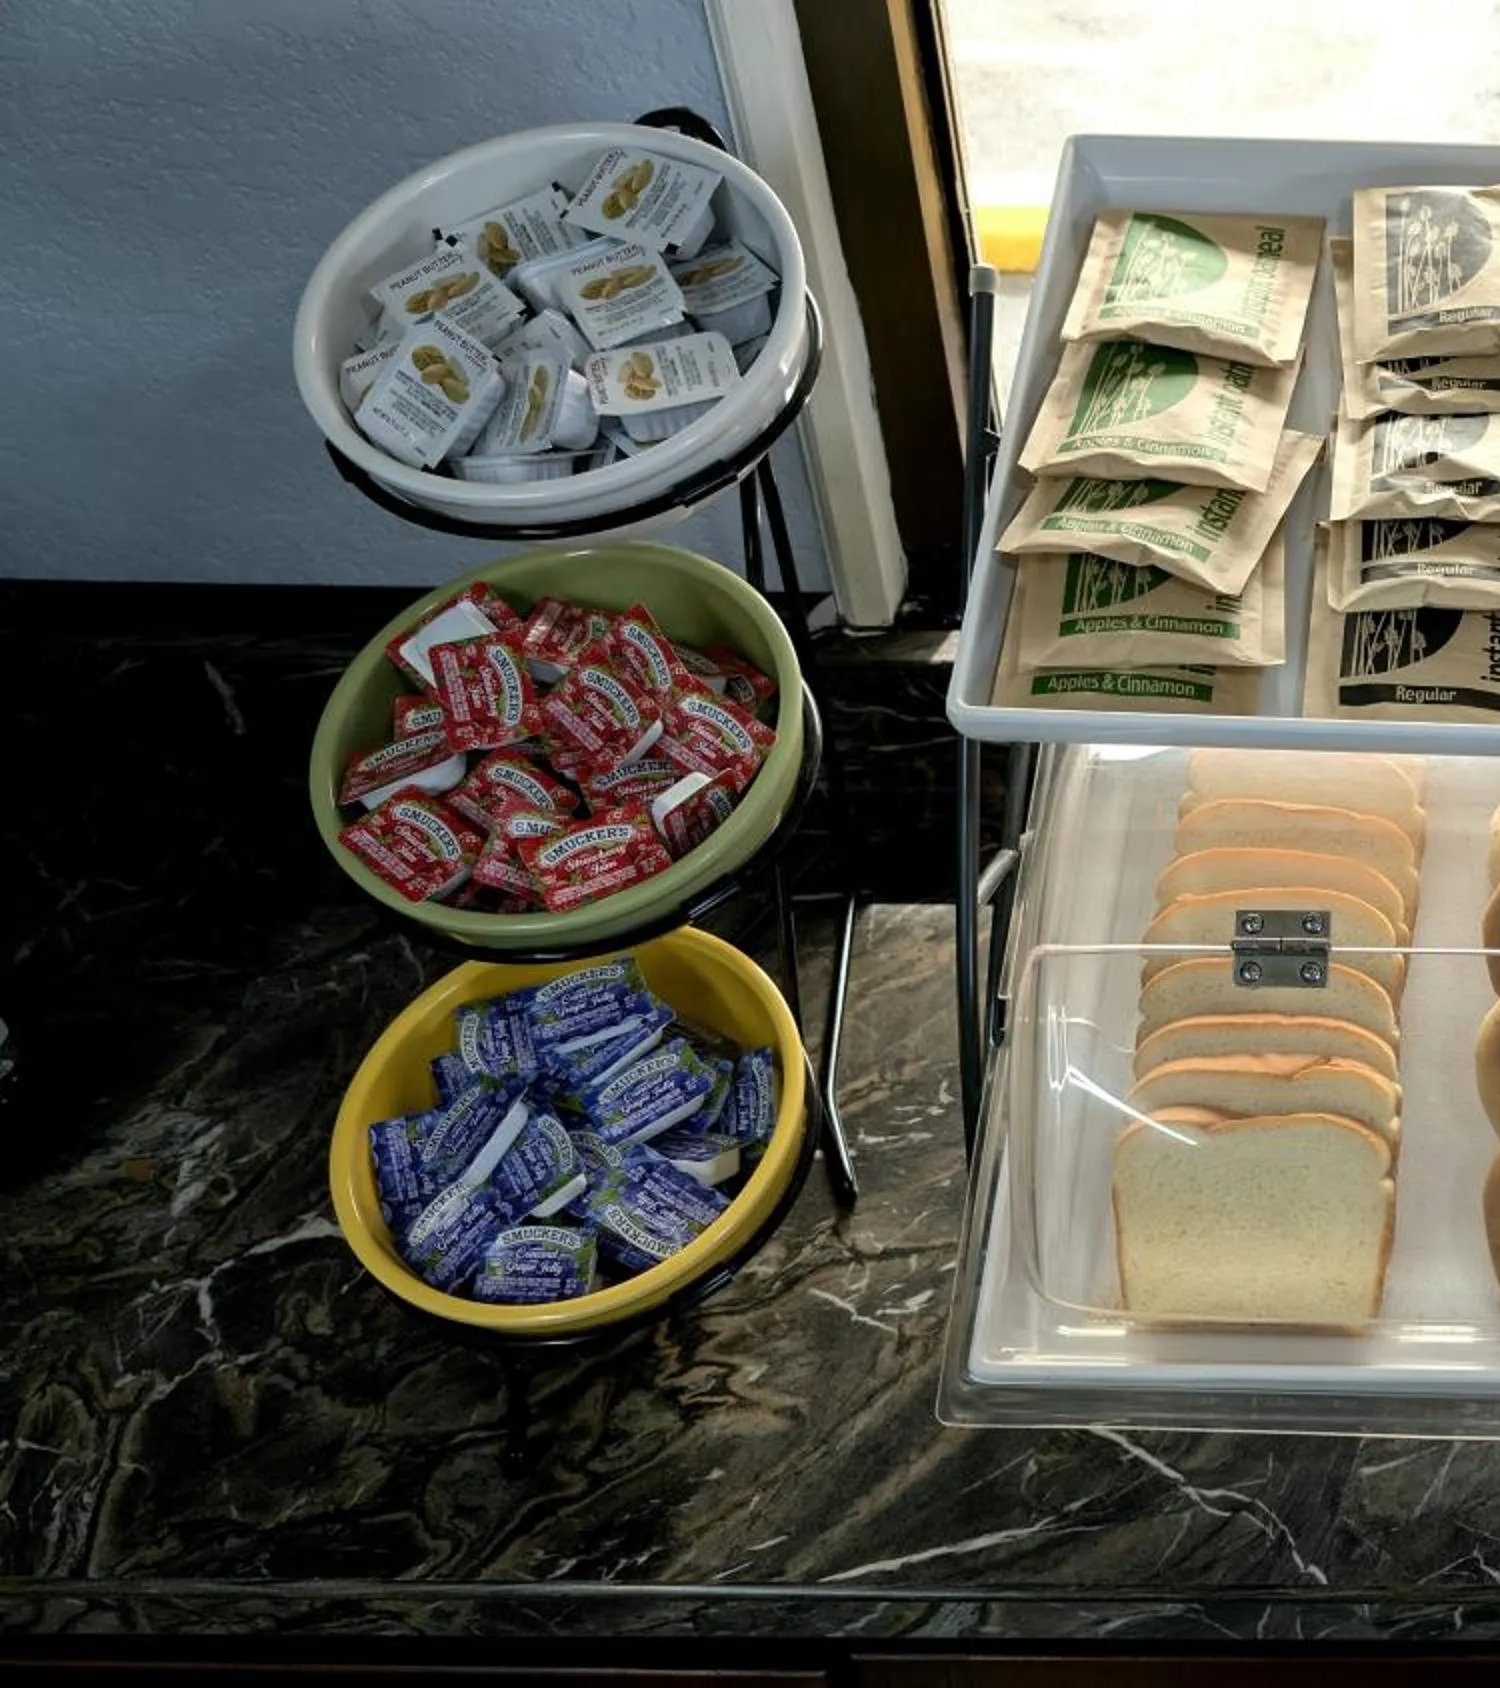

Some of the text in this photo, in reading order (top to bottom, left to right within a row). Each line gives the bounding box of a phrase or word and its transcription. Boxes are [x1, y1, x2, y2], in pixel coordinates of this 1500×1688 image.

[1186, 488, 1246, 541] instan
[1075, 616, 1224, 634] Apples & Cinnamon
[1048, 676, 1196, 697] Apples & Cinnamon
[1395, 685, 1457, 703] Regular
